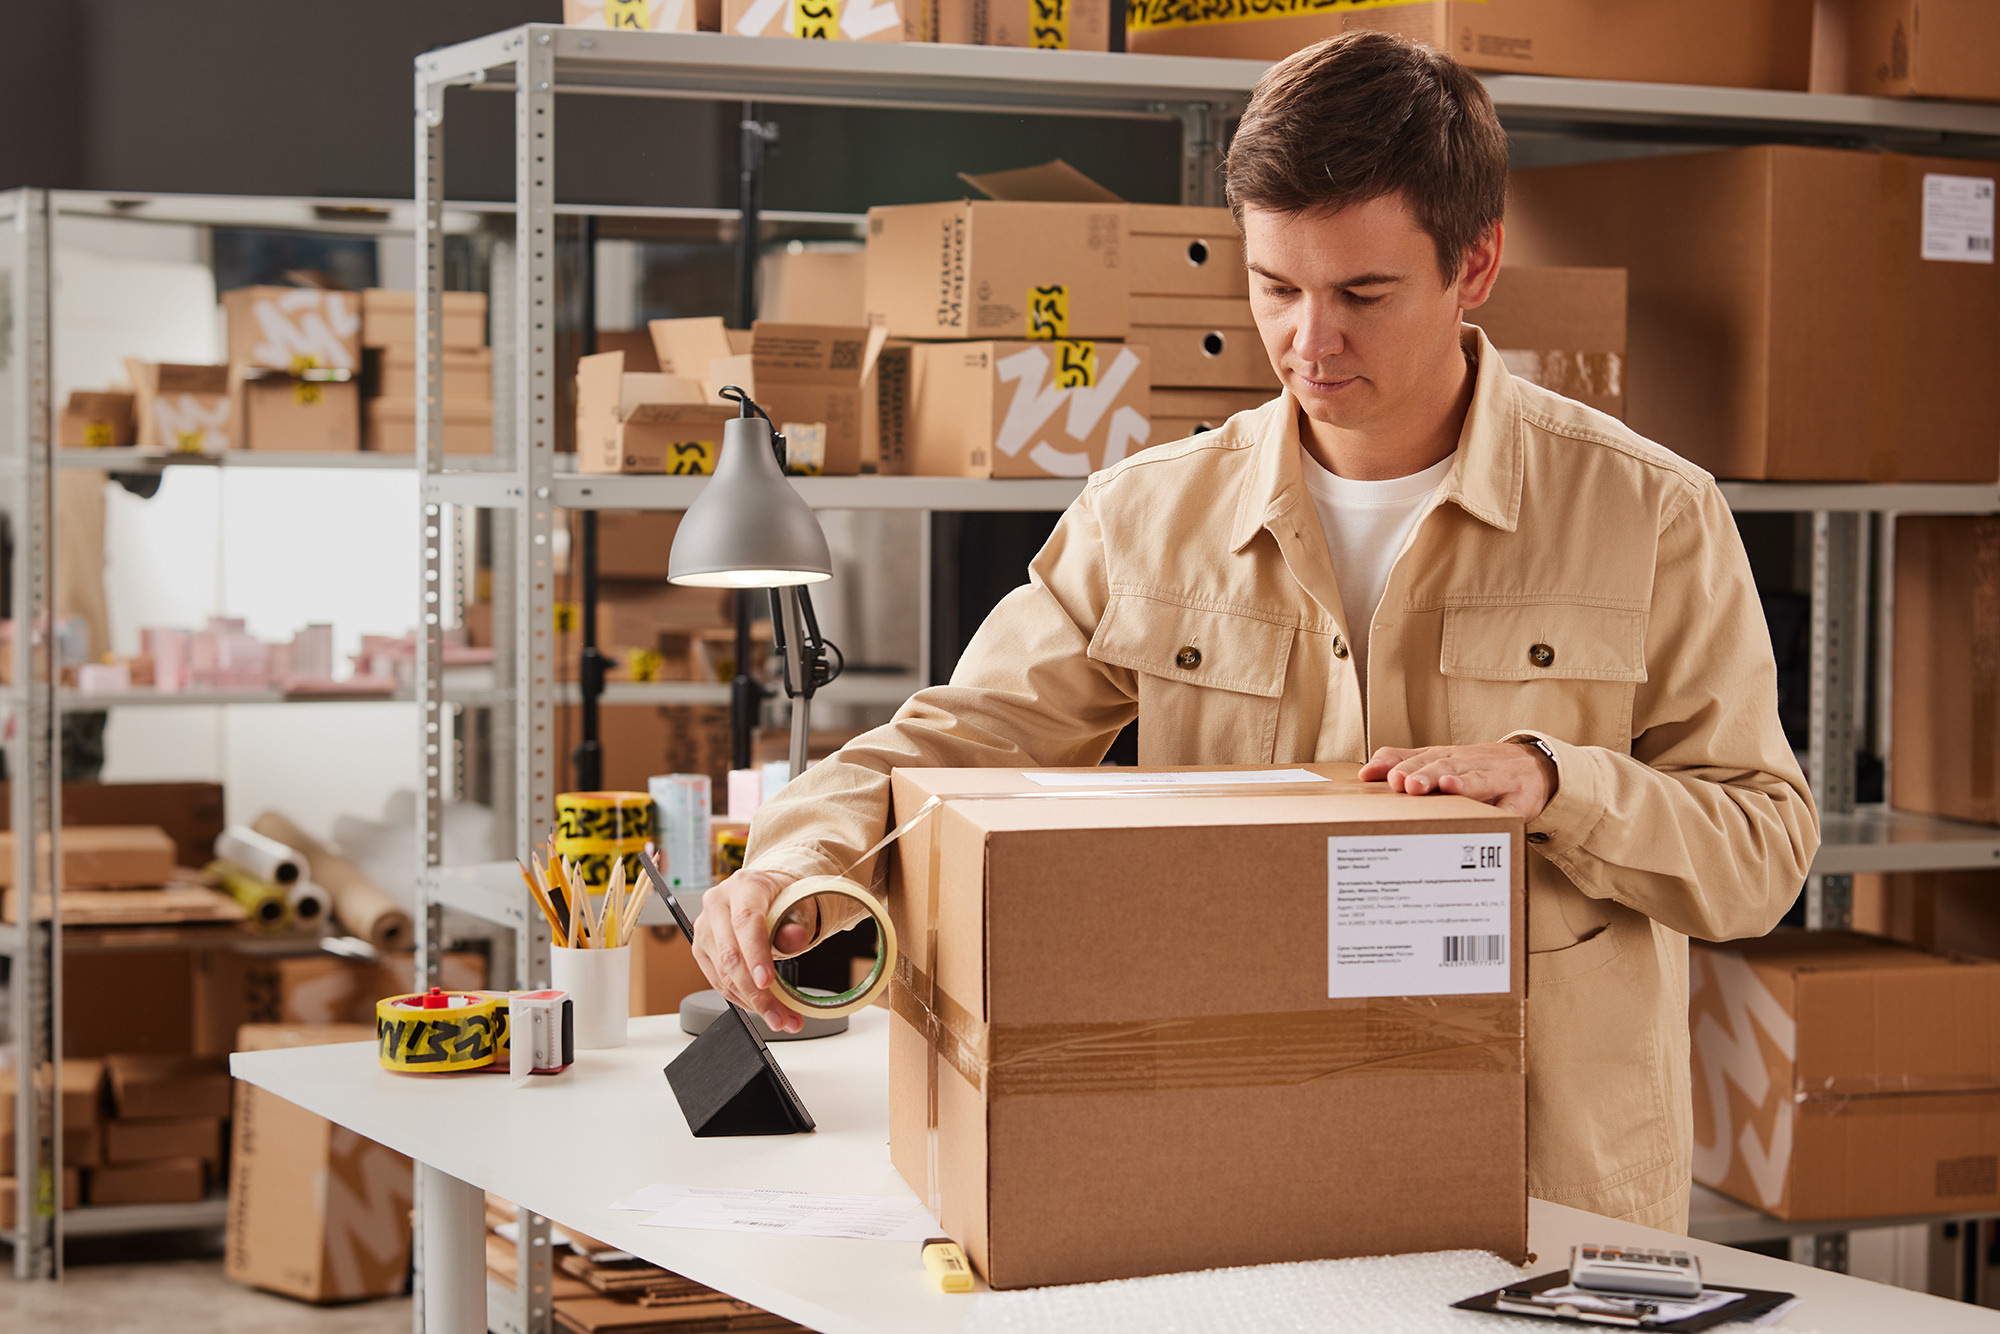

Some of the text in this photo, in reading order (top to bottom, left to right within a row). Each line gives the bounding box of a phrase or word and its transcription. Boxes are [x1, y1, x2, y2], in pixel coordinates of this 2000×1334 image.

[937, 217, 951, 327] Яндекс
[950, 213, 965, 328] Маркет
[1481, 846, 1502, 868] EAC
